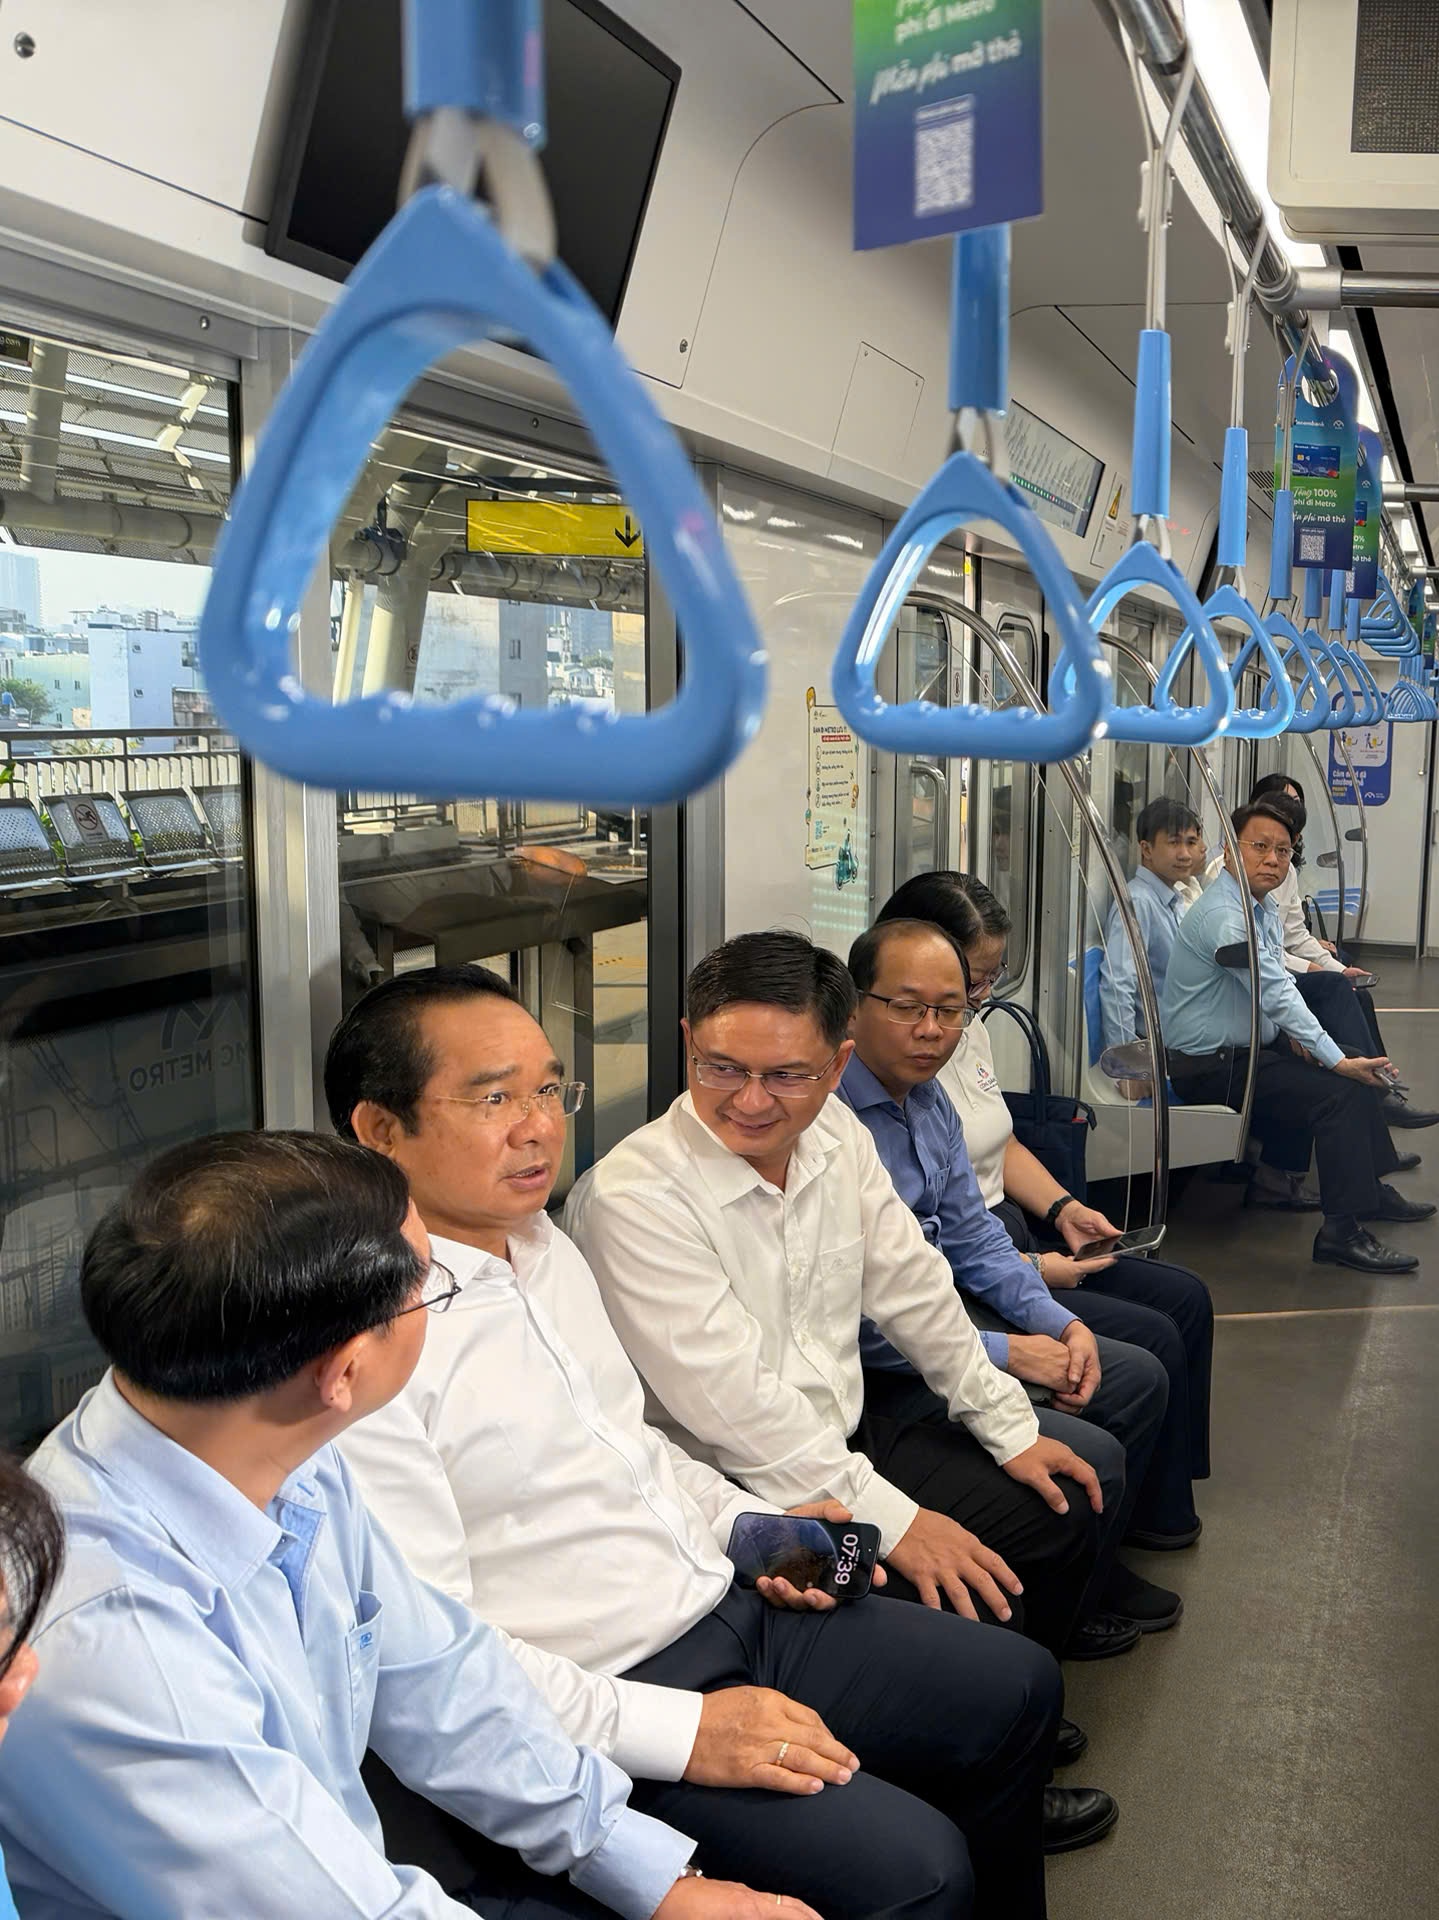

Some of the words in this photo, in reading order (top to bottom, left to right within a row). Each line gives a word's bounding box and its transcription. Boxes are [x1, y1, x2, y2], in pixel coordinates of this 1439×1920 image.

[1313, 488, 1338, 499] 100%
[1314, 499, 1337, 508] Metro
[834, 1533, 859, 1585] 07:39
